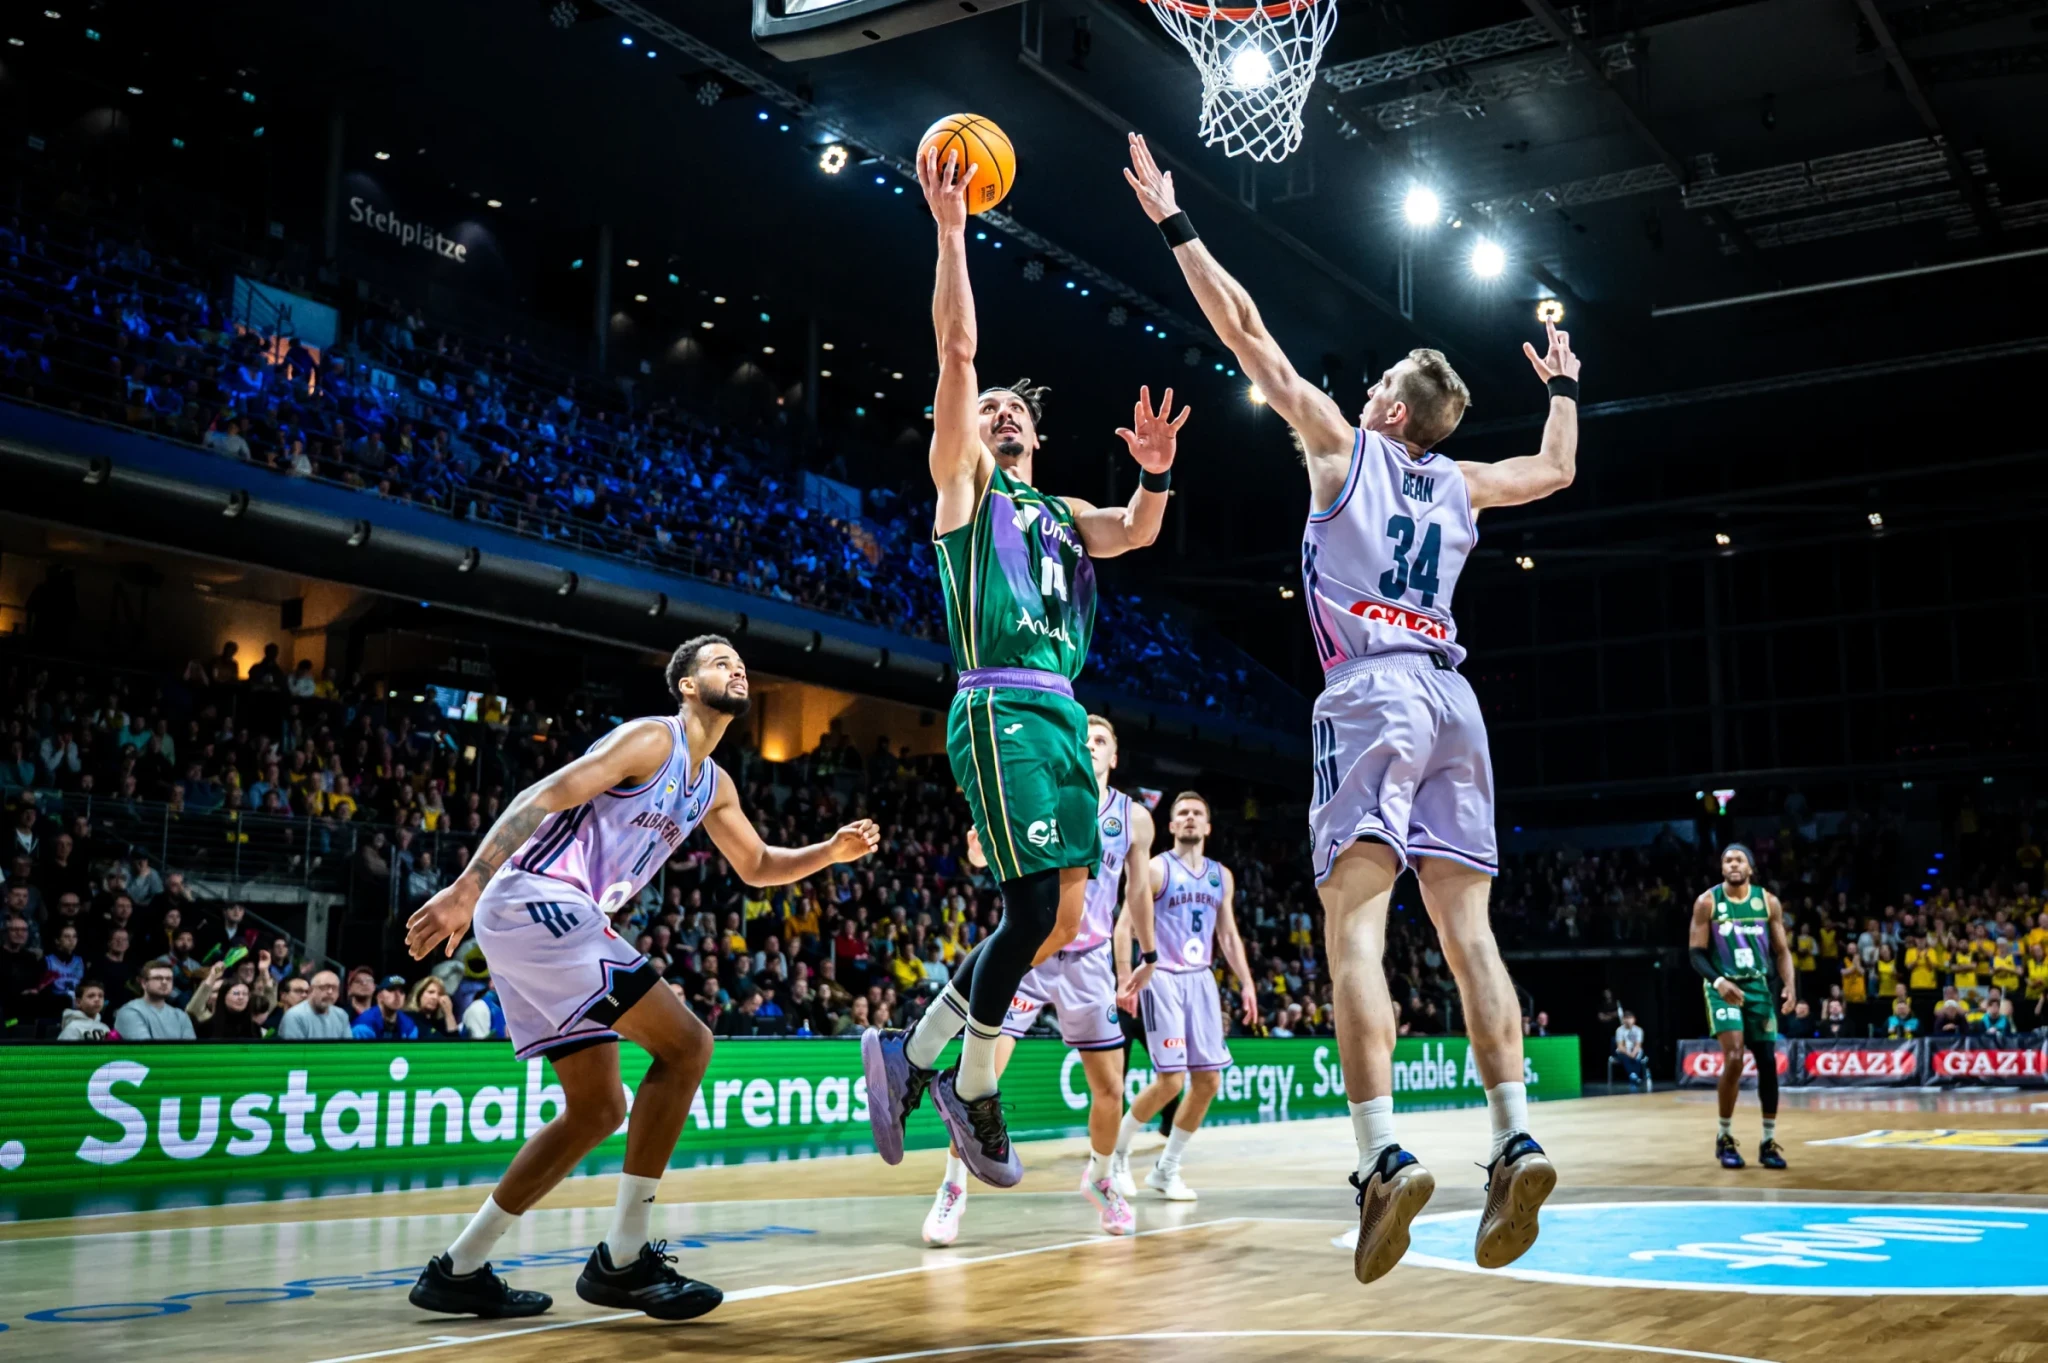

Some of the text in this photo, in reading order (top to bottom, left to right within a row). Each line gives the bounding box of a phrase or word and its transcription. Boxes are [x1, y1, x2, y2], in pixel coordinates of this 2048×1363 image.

[350, 197, 466, 262] Stehplätze
[1402, 471, 1435, 503] BEAN
[1378, 514, 1442, 608] 34
[1100, 850, 1116, 868] LIN
[1168, 892, 1193, 908] ALBA
[1313, 1043, 1457, 1098] Sunable
[1816, 1052, 1904, 1075] GAZI
[76, 1056, 634, 1165] Sustainab
